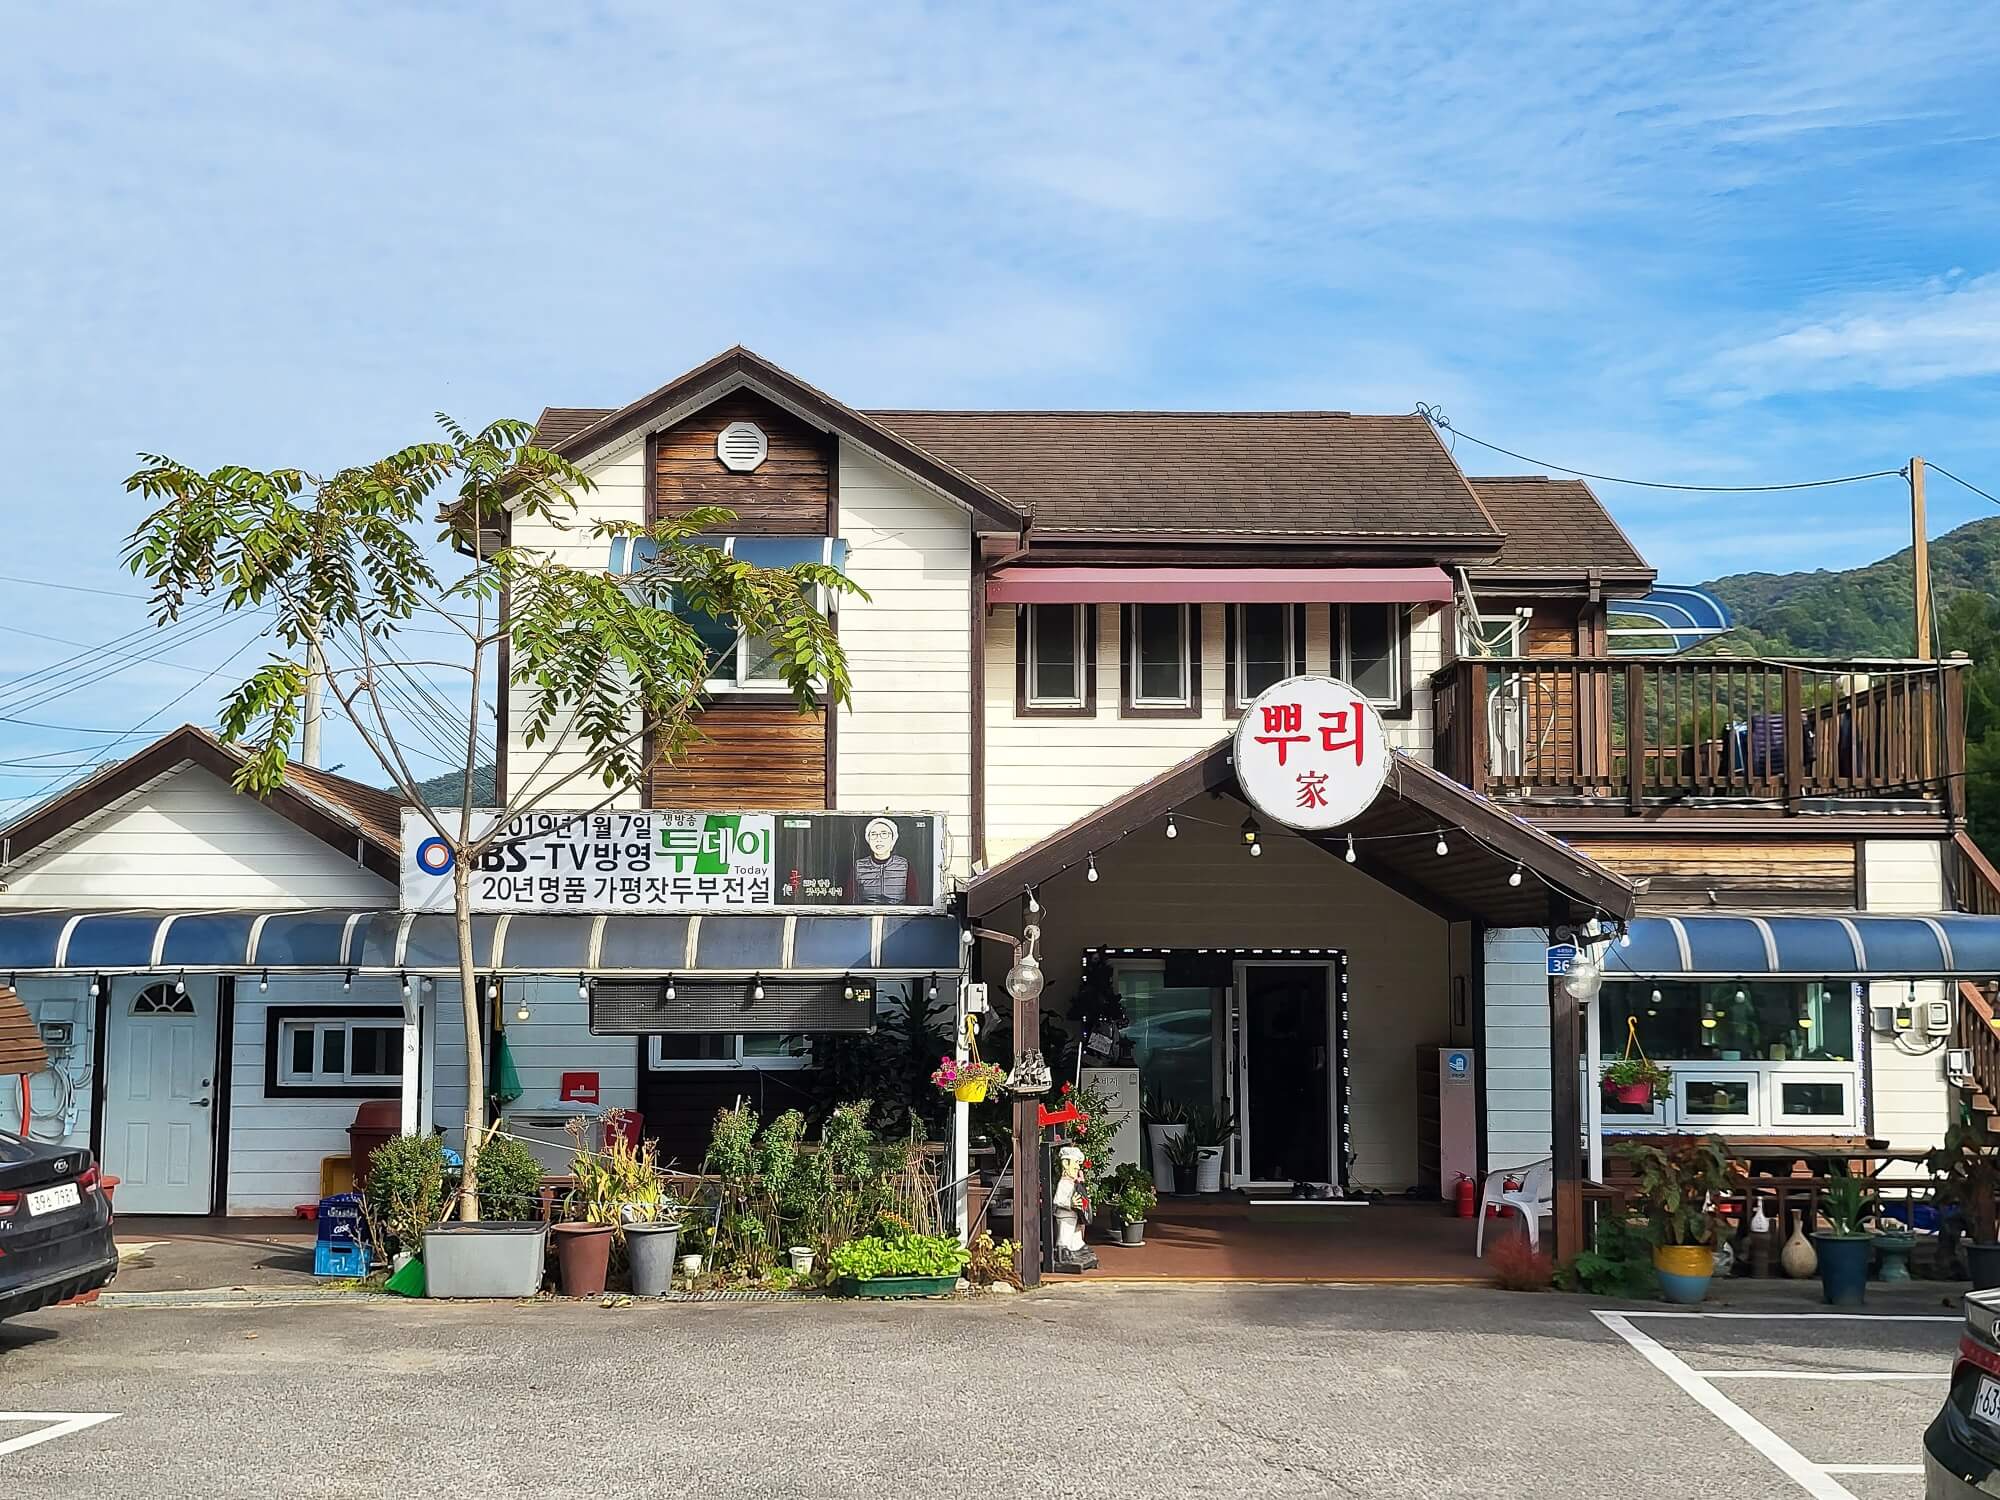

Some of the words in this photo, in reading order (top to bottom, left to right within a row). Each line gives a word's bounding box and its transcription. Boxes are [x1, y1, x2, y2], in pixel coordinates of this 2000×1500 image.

[1254, 699, 1364, 767] 뿌리
[1295, 770, 1329, 809] 家
[618, 815, 652, 840] 7일
[654, 827, 770, 873] 투데이
[734, 865, 768, 876] Today
[1552, 959, 1570, 972] 36
